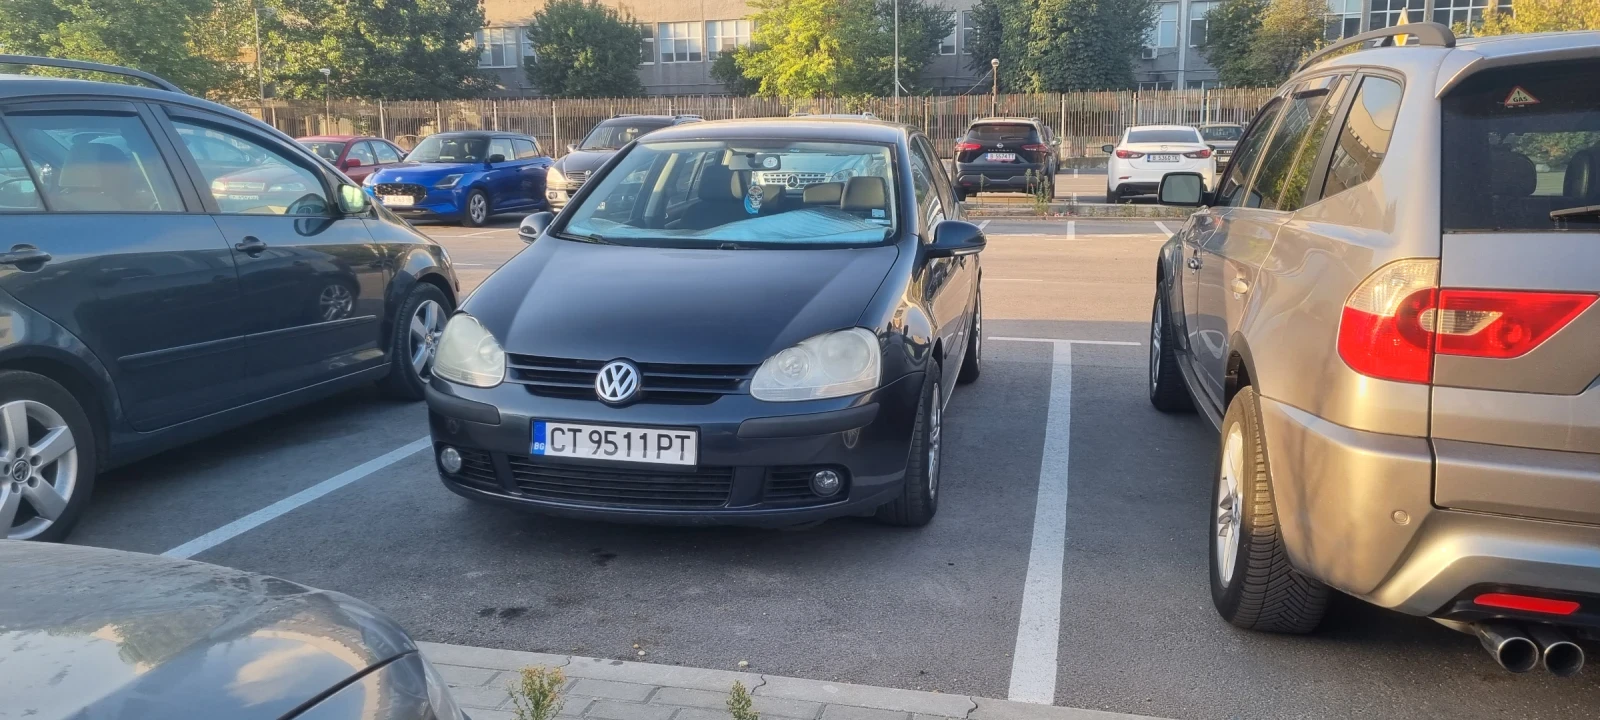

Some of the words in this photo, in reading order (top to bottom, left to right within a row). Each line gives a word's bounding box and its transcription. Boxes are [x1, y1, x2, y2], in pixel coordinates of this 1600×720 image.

[597, 362, 638, 401] VW
[534, 442, 545, 450] BG
[551, 427, 582, 453] CT
[588, 430, 647, 458] 9511
[656, 434, 691, 461] PT
